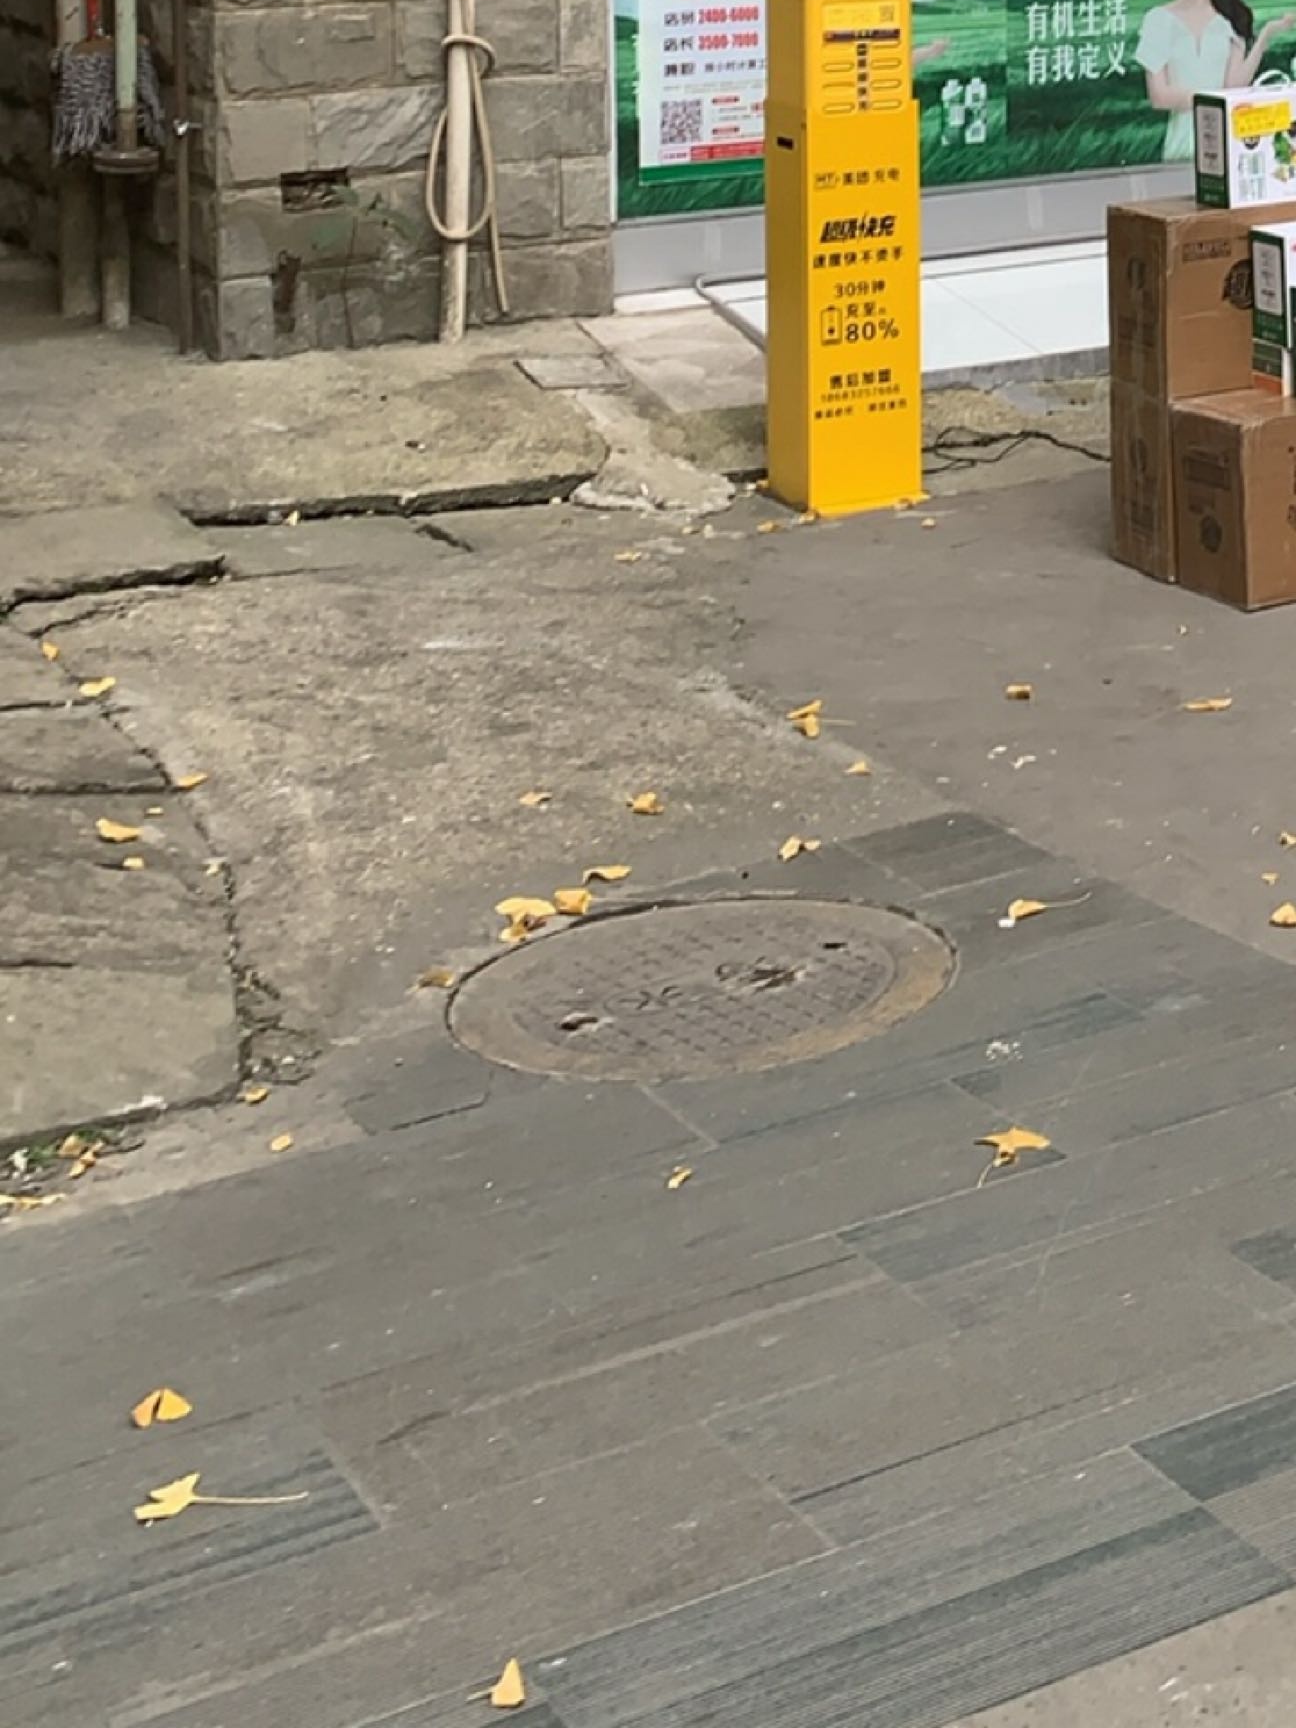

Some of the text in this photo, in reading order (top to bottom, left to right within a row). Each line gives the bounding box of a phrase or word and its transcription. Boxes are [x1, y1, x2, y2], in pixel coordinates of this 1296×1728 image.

[1025, 41, 1128, 86] 有我定义
[845, 318, 900, 344] 80%
